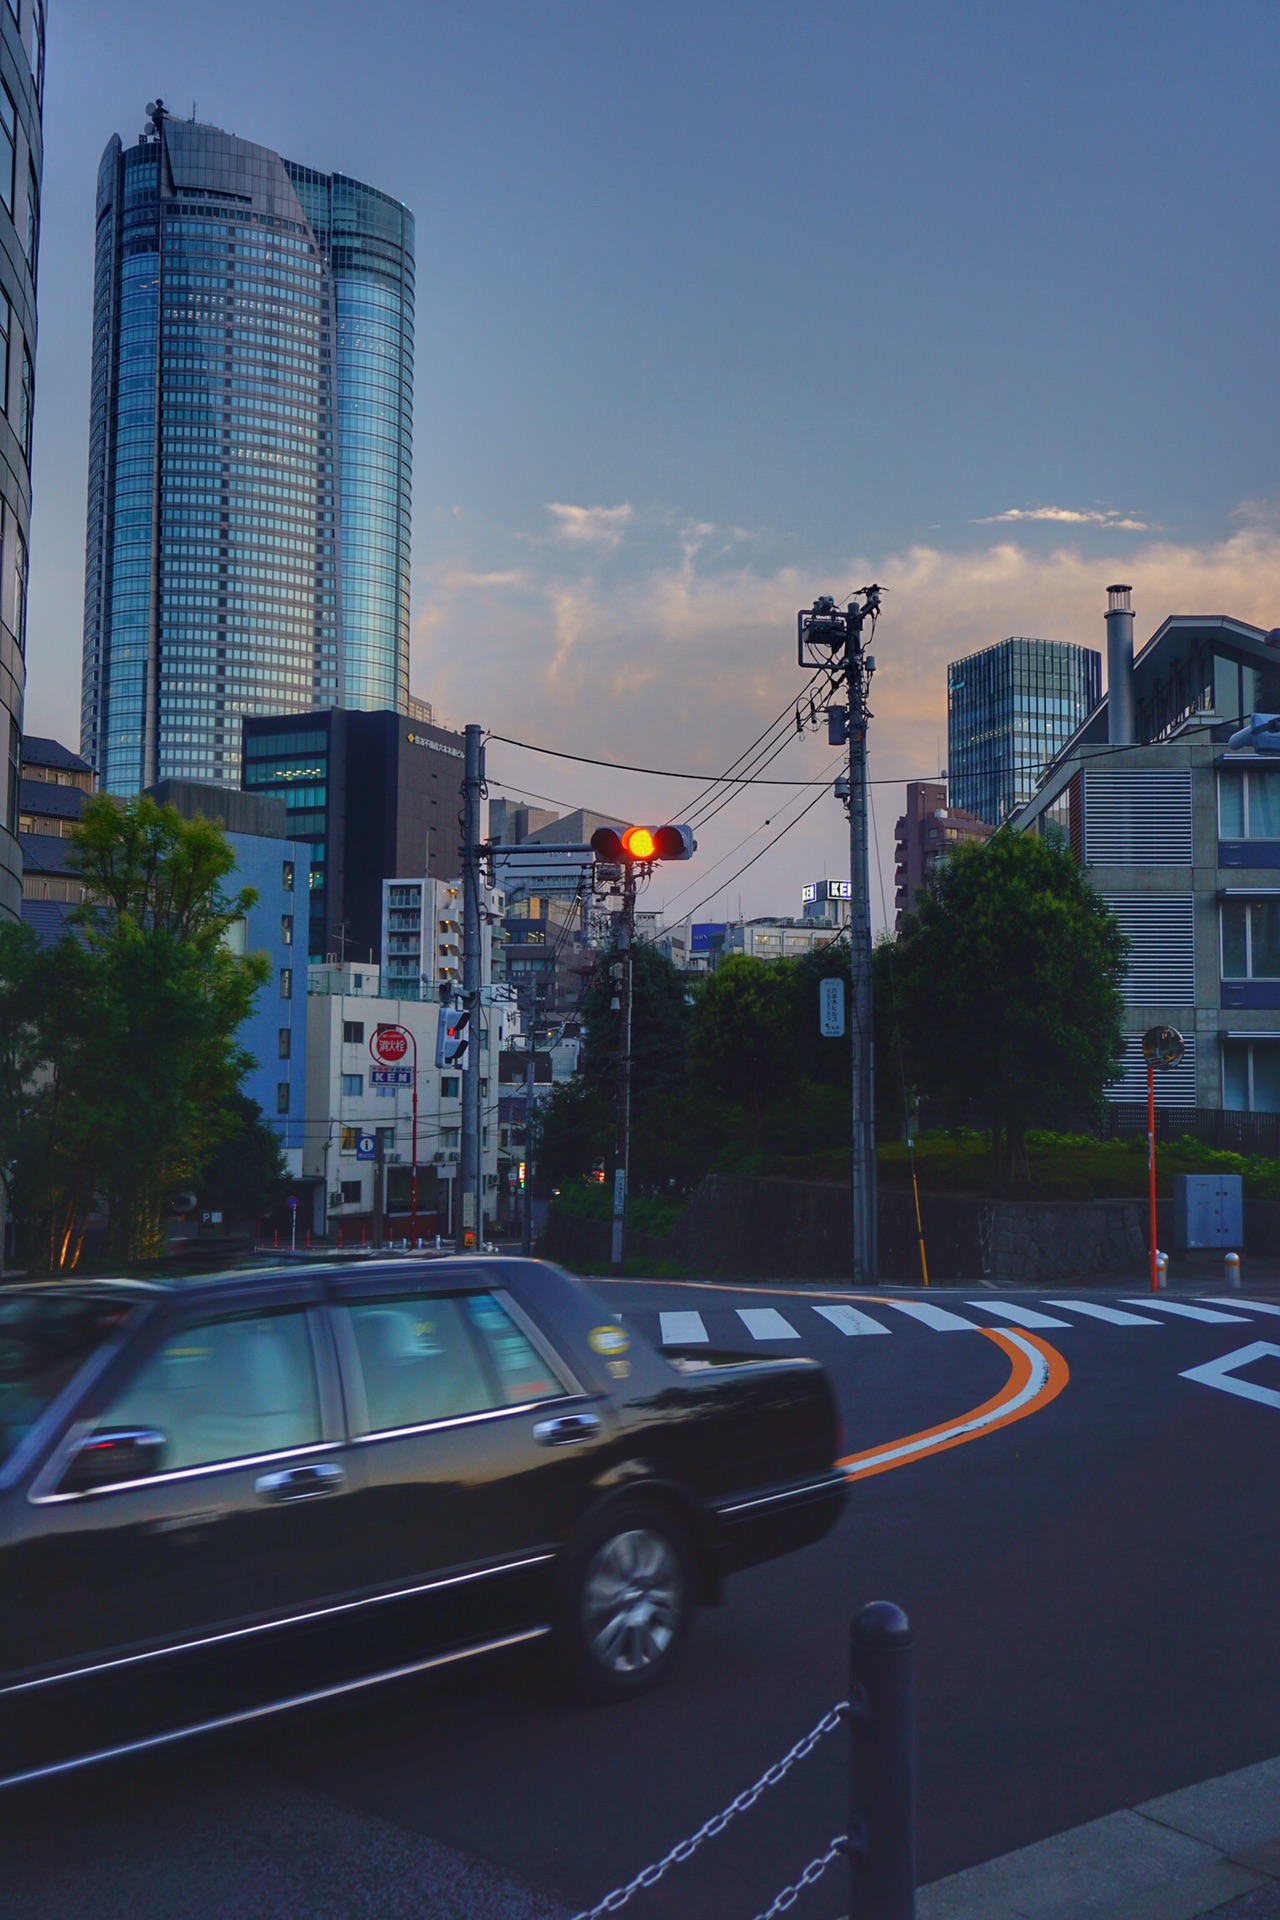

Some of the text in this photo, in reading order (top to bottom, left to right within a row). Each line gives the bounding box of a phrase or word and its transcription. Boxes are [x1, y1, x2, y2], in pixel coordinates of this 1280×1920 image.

[379, 1040, 405, 1052] 消火栓
[376, 1073, 407, 1082] KEN
[203, 1212, 210, 1222] P
